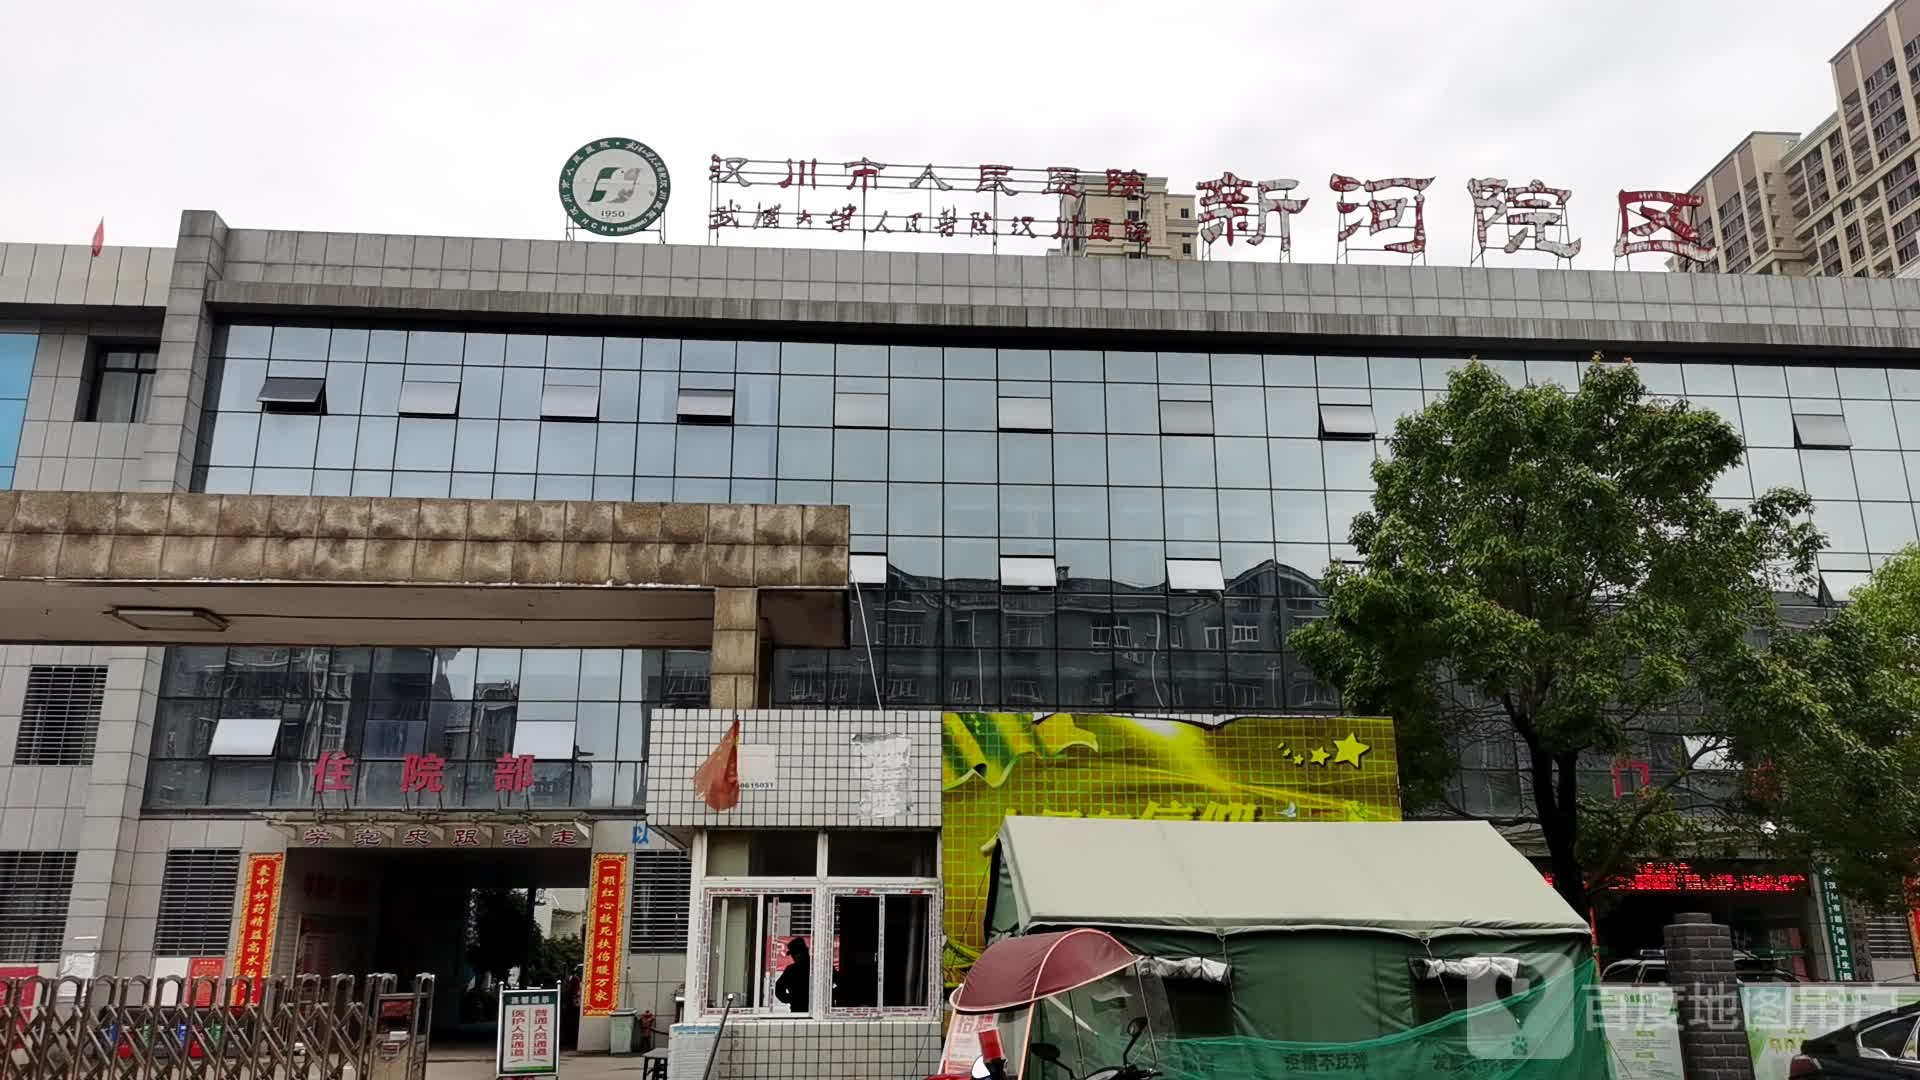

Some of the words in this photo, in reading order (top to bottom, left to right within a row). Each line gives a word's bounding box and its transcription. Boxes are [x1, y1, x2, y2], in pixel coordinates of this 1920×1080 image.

[709, 154, 1150, 199] 汉川市人民医院
[1196, 171, 1718, 262] 新河院区
[312, 752, 536, 793] 住院部
[303, 828, 578, 846] 学党史跟党走
[512, 1009, 526, 1056] 医护人员通道
[534, 1009, 548, 1056] 普通人员通道
